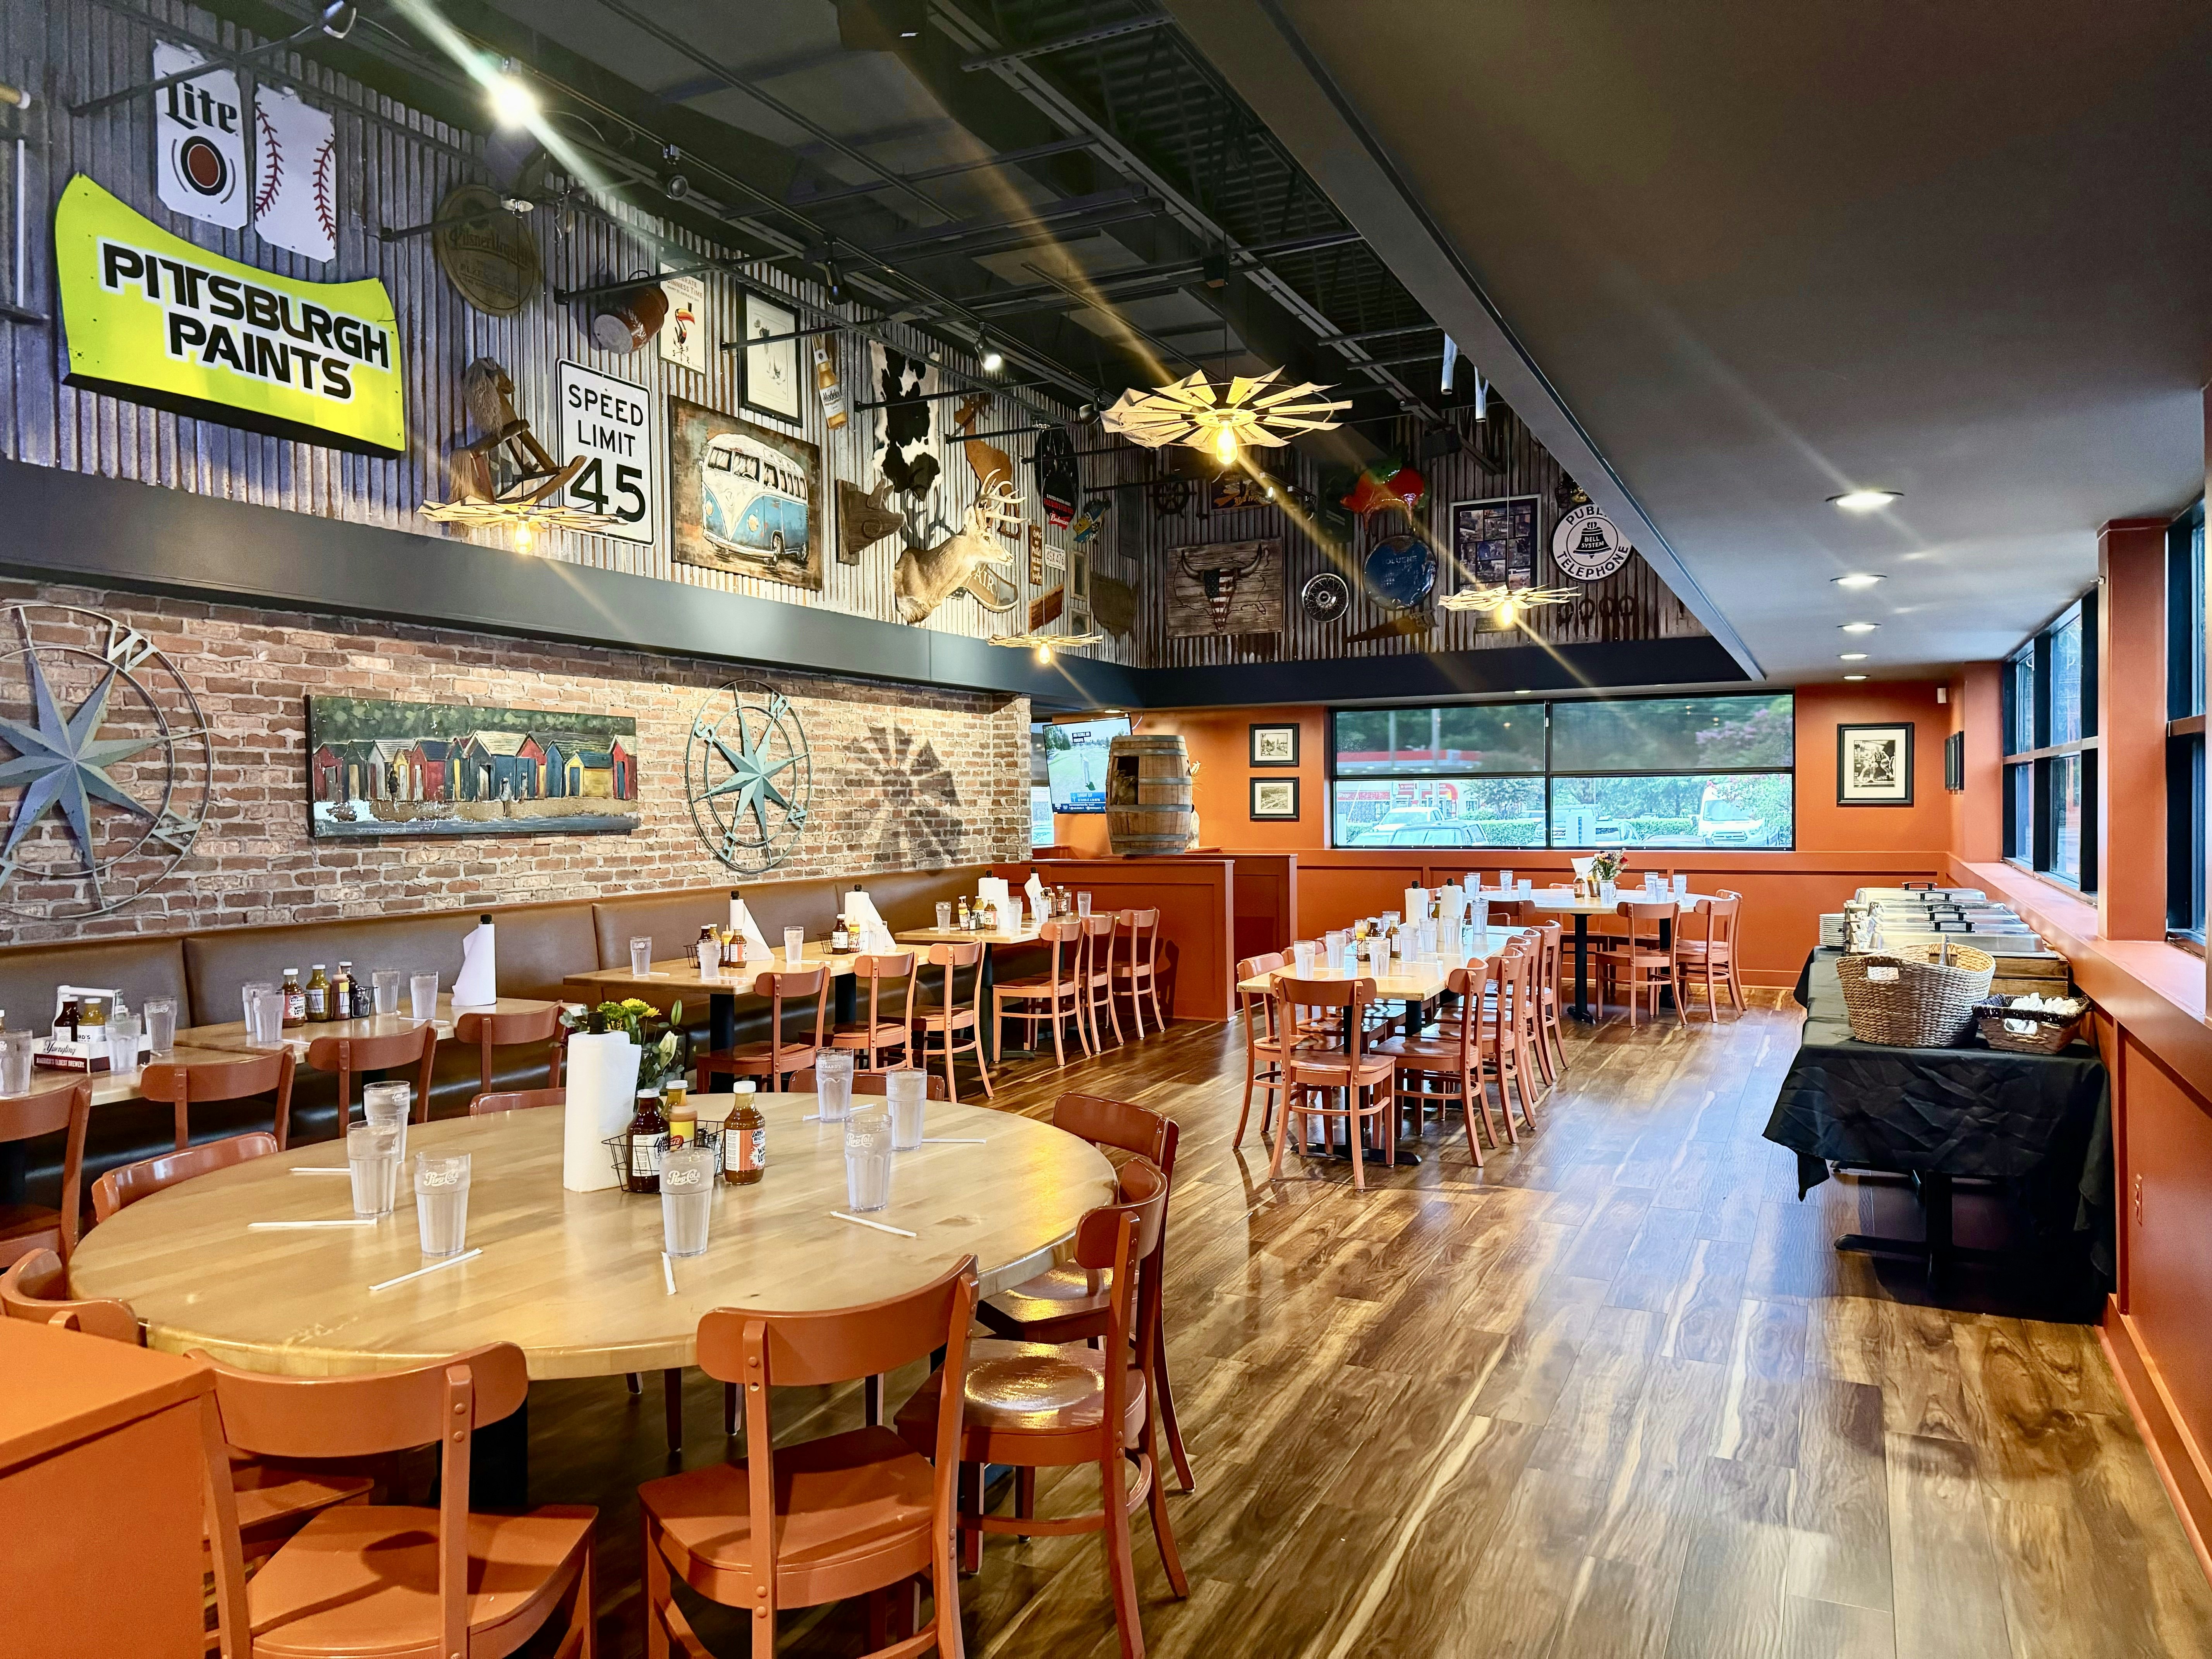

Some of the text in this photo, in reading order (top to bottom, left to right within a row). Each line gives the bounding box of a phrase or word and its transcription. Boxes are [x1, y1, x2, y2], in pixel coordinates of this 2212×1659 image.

[163, 71, 237, 134] Lite
[103, 242, 388, 368] PITTSBURGH
[690, 287, 703, 299] TIME
[168, 312, 351, 399] PAINTS
[568, 384, 644, 427] SPEED
[577, 420, 635, 457] LIMIT
[570, 458, 646, 523] 45
[1566, 506, 1607, 525] PUBL
[1553, 546, 1628, 578] TELEPHONE
[974, 567, 994, 595] AIR
[44, 1040, 76, 1055] Yuengling
